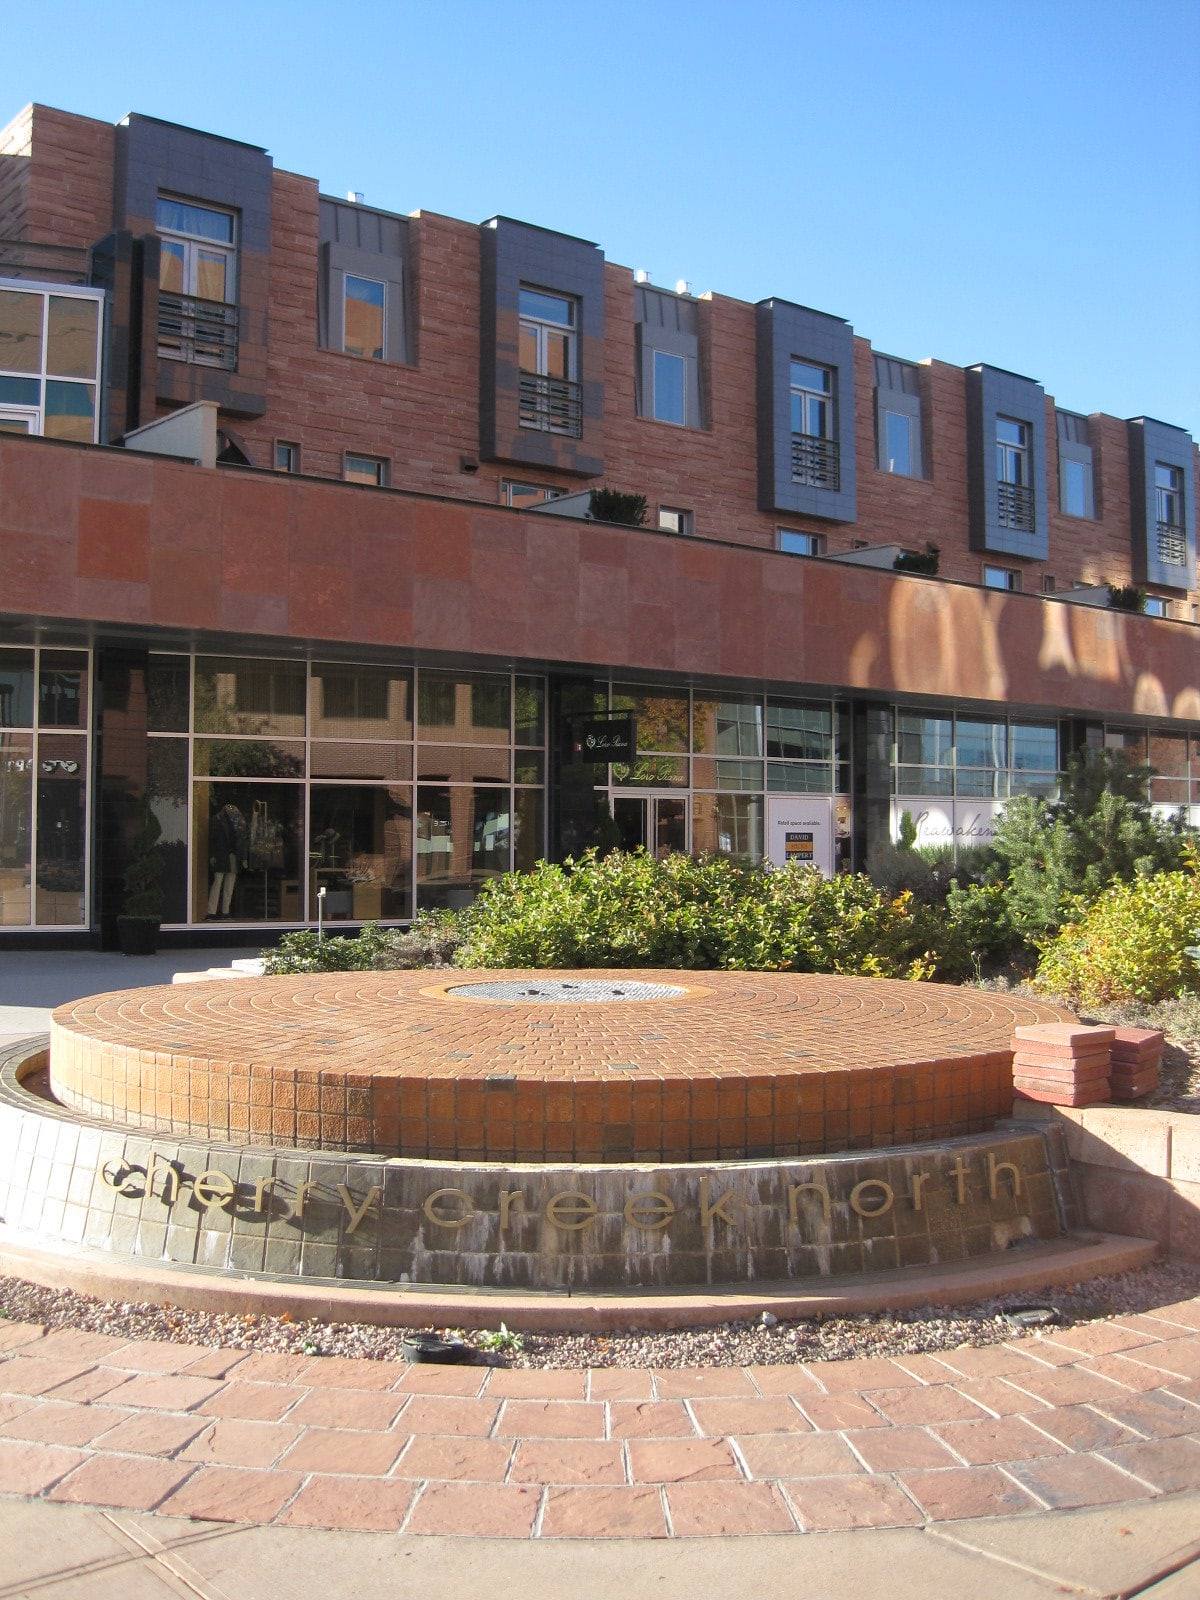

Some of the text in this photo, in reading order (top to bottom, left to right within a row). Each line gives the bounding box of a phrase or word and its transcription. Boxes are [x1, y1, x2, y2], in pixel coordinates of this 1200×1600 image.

[630, 761, 686, 781] Loro Piana
[97, 1151, 1023, 1235] cherry creek north
